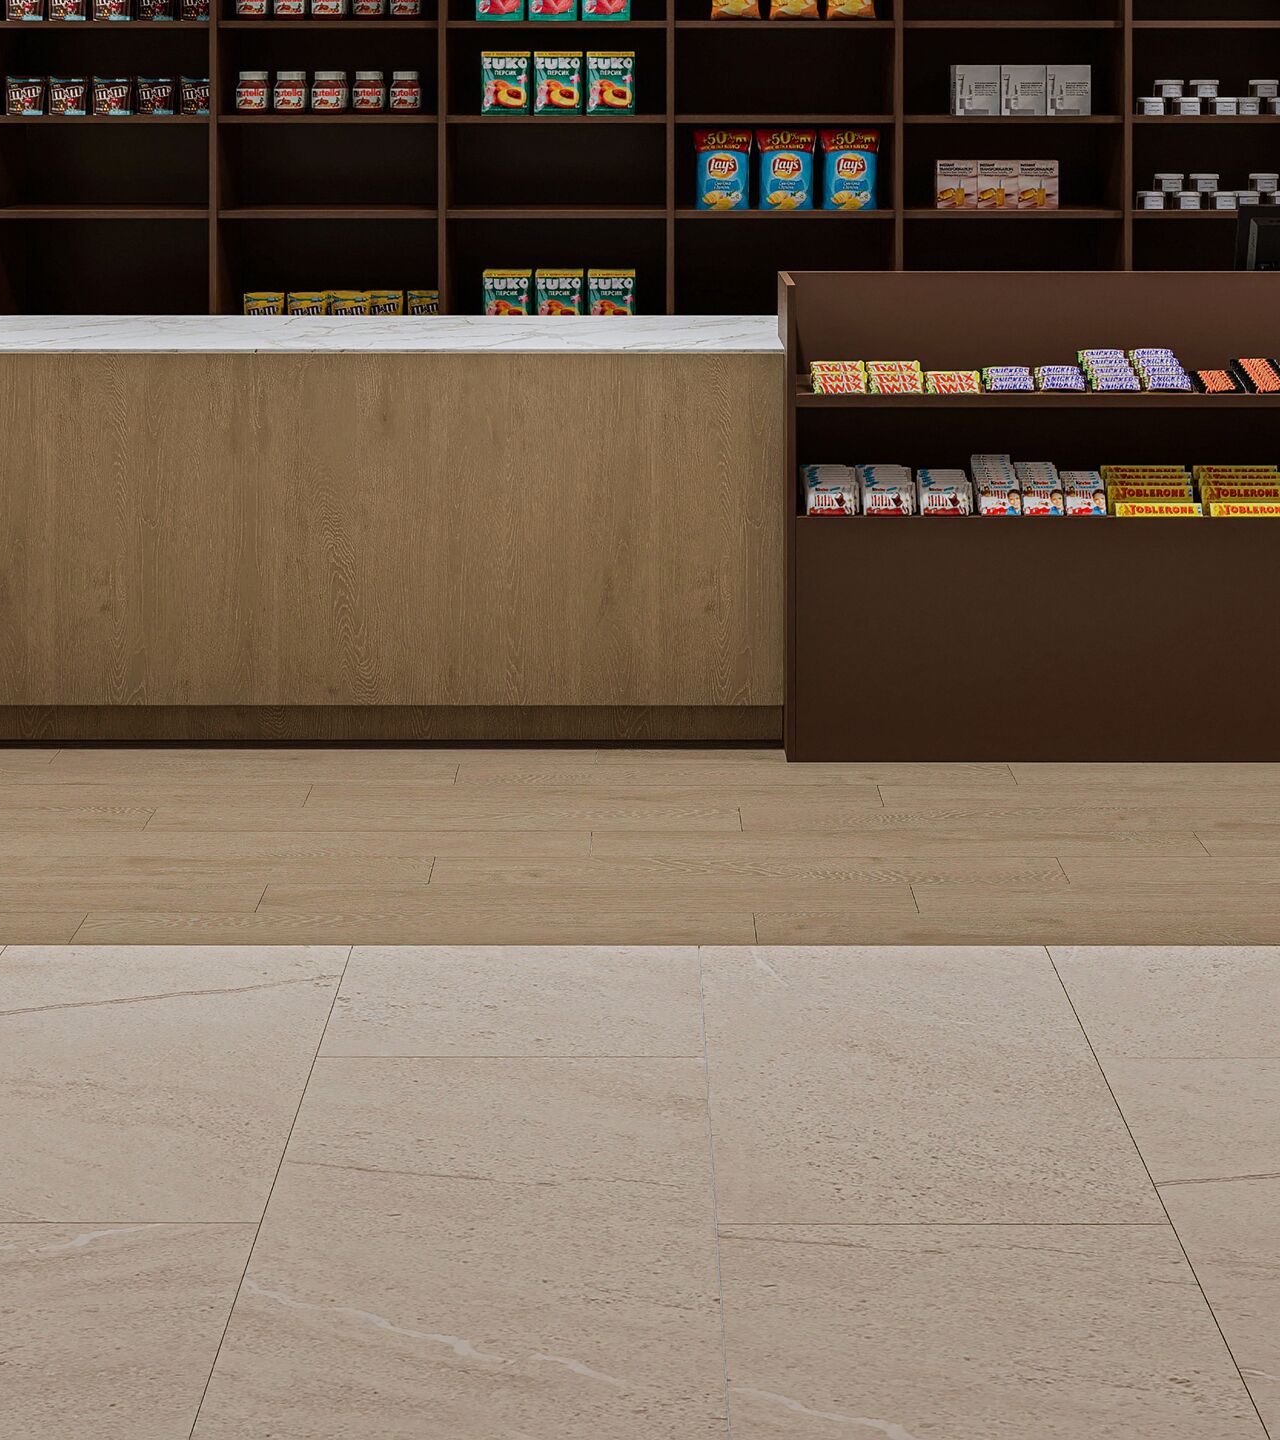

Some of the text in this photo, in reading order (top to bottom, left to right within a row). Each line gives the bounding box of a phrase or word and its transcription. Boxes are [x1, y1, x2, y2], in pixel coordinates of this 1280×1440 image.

[483, 57, 528, 70] ZUKO
[536, 57, 580, 70] ZUKO
[588, 57, 633, 70] ZUKO
[237, 90, 264, 98] nutella
[274, 90, 302, 98] nutella
[312, 90, 340, 98] nutella
[354, 90, 381, 98] nutella
[391, 90, 419, 98] nutella
[709, 158, 735, 174] Lay's
[774, 158, 800, 174] Lay's
[838, 158, 864, 174] Lay's
[484, 278, 529, 290] ZUKO
[536, 278, 581, 290] ZUKO
[589, 278, 634, 290] ZUKO
[1120, 487, 1185, 498] TOBLERONE
[1215, 487, 1280, 498] TOBLERONE
[1129, 504, 1194, 515] TOBLERONE
